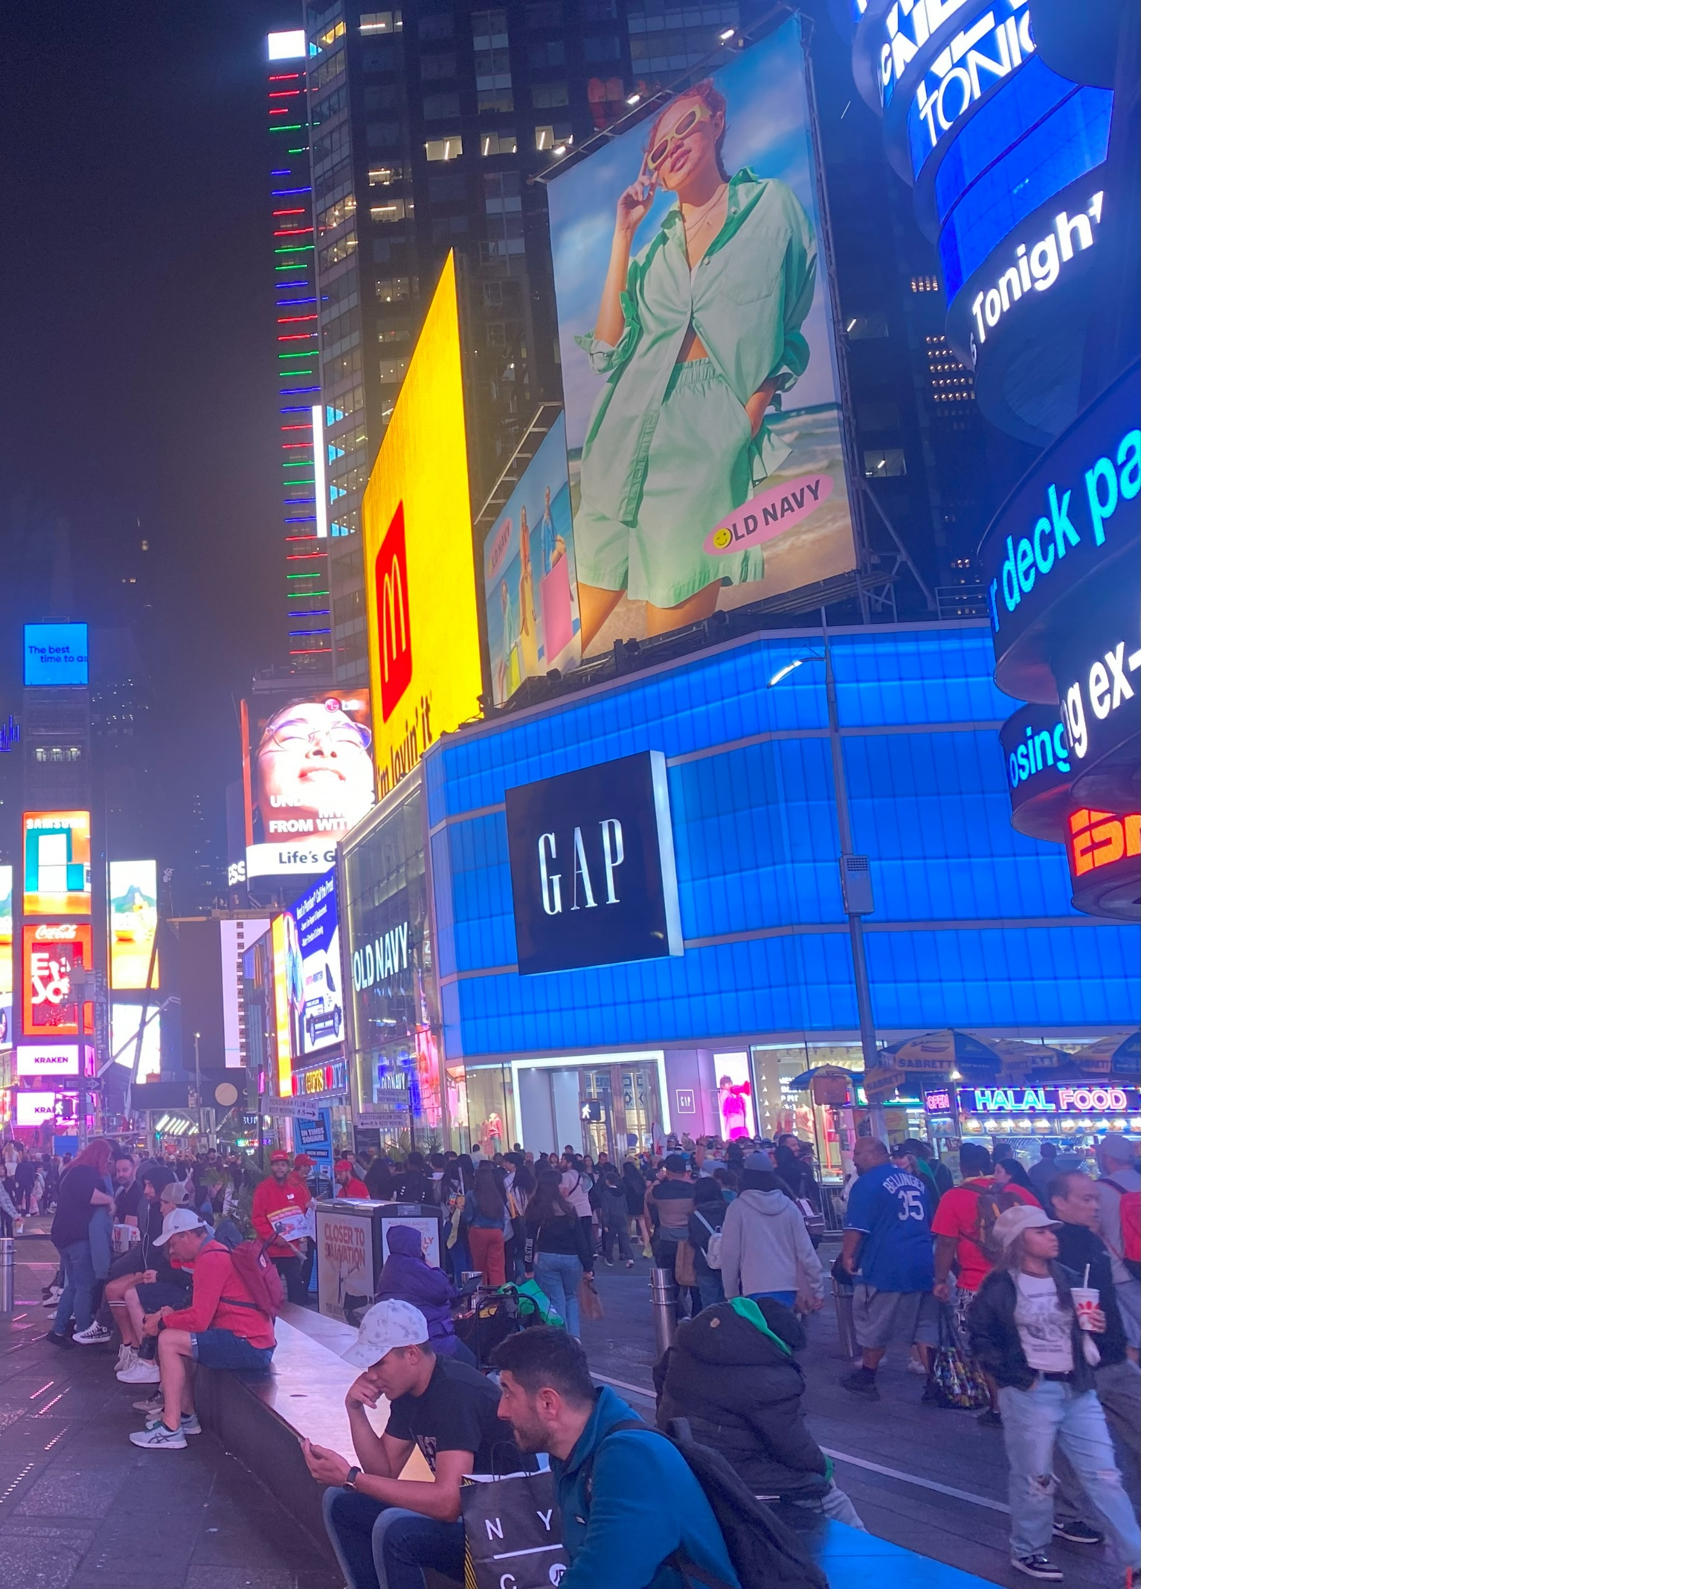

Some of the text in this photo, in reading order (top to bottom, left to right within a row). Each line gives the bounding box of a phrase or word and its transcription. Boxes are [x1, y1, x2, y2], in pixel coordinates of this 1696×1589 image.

[763, 479, 821, 528] NAVY
[1003, 483, 1081, 612] deck
[1085, 429, 1141, 547] pa
[28, 645, 70, 654] The best
[40, 655, 62, 663] time
[64, 655, 75, 663] to
[420, 694, 433, 752] it
[26, 818, 87, 829] SAMSUNG
[270, 819, 313, 833] FROM
[279, 851, 319, 865] Life's
[538, 818, 625, 915] GAP
[354, 921, 408, 992] OLD NAVY
[34, 1056, 69, 1064] KRAKEN
[898, 1059, 953, 1069] SABRETT
[926, 1094, 950, 1110] OPEN
[975, 1089, 1128, 1110] HALAL FOOD
[279, 1107, 295, 1115] MOVING
[882, 1172, 925, 1194] BELLINGER
[898, 1190, 925, 1221] 35
[324, 1223, 365, 1246] CLOSER TO
[324, 1243, 365, 1267] SALVATION
[485, 1509, 553, 1540] N Y
